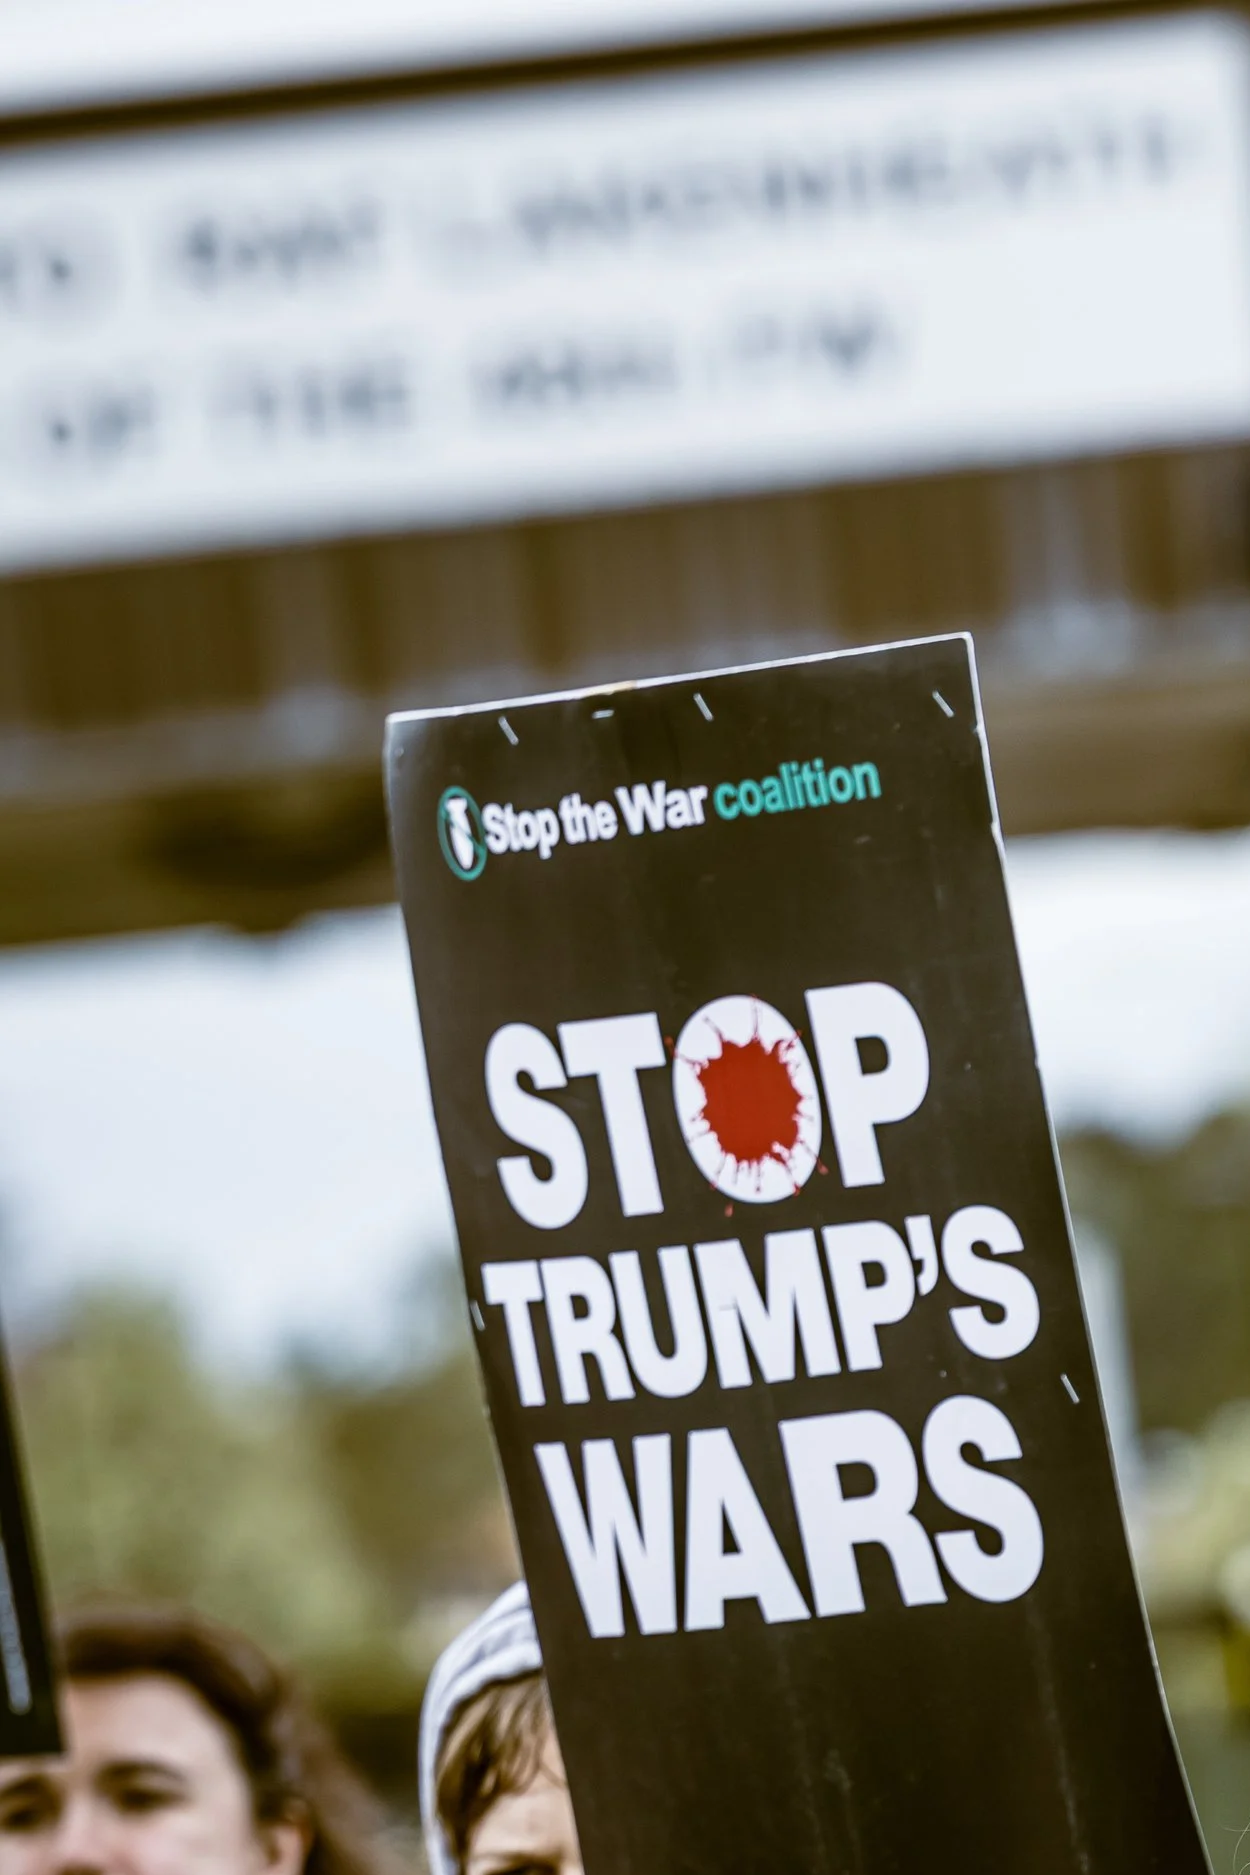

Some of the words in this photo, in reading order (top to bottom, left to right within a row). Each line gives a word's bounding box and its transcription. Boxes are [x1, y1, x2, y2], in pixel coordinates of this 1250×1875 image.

[482, 803, 560, 860] Stop
[558, 793, 618, 845] the
[614, 780, 707, 835] War
[714, 757, 882, 820] coalition
[484, 981, 930, 1230] STOP
[481, 1205, 1040, 1407] TRUMP'S
[533, 1394, 1044, 1639] WARS
